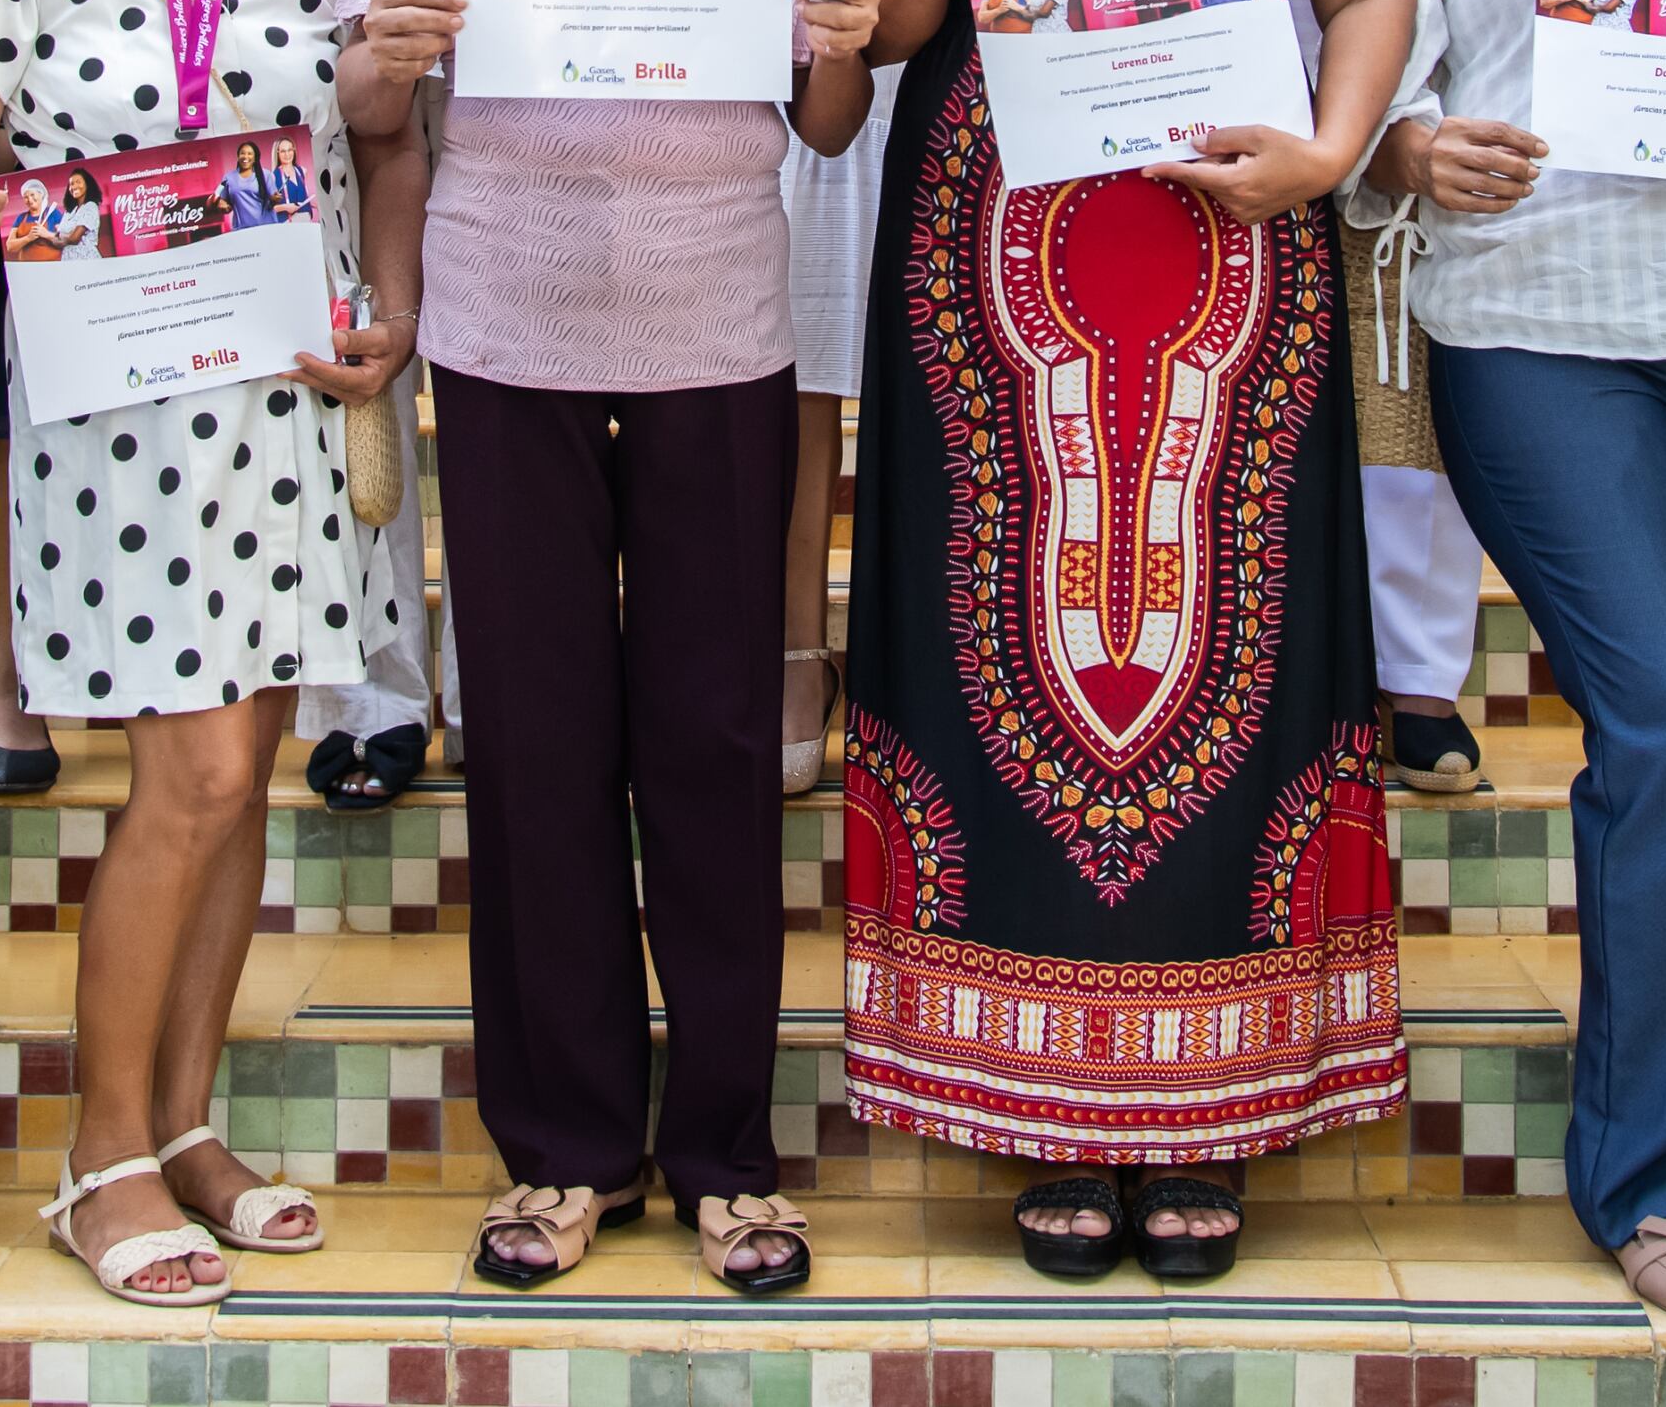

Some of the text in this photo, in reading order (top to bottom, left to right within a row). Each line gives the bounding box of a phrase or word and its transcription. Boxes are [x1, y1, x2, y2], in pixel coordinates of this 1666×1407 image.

[589, 66, 616, 74] Gases
[635, 62, 687, 79] Brilla
[1110, 55, 1149, 71] Lorena
[596, 75, 625, 83] Caribe
[1125, 135, 1151, 146] Gases
[1134, 141, 1162, 153] Caribe
[134, 183, 170, 199] Premio
[115, 192, 179, 217] Mujeres
[123, 203, 204, 235] Brillantes
[140, 277, 197, 297] Yanet Lara
[191, 349, 240, 370] Brilla
[149, 364, 175, 375] Gases
[157, 370, 185, 382] Caribe
